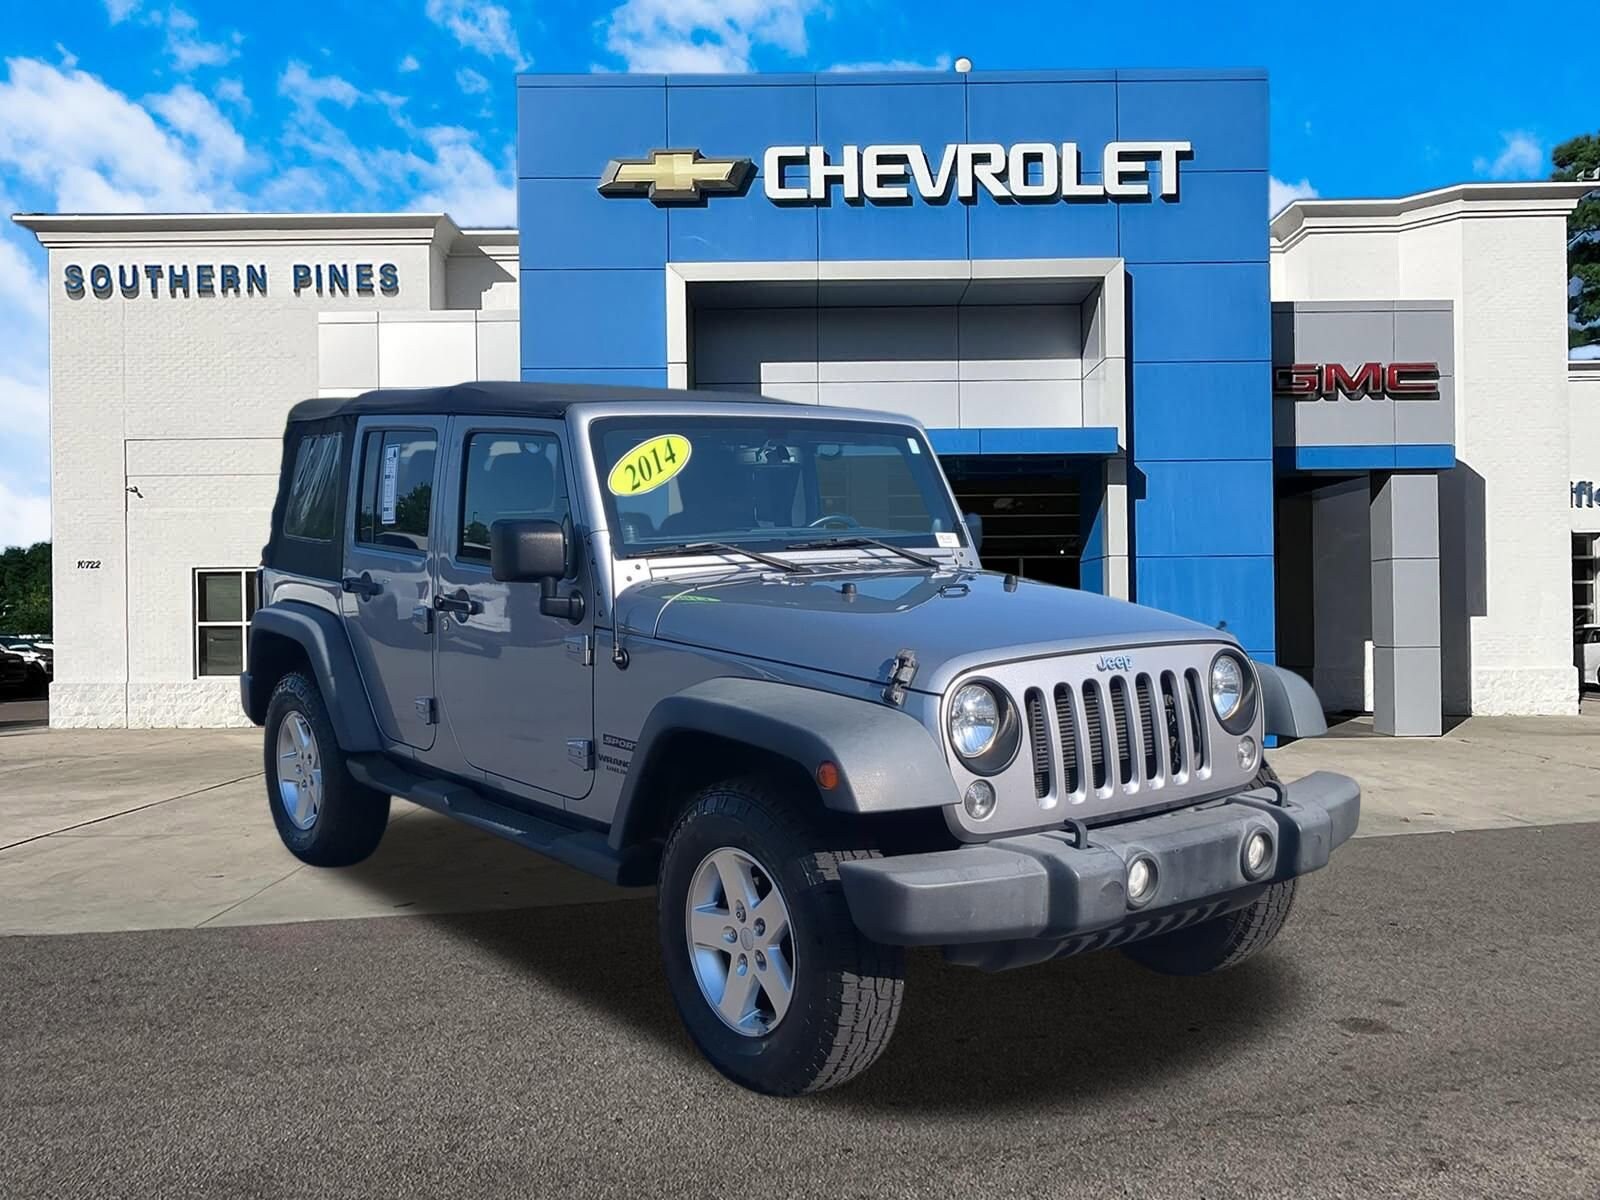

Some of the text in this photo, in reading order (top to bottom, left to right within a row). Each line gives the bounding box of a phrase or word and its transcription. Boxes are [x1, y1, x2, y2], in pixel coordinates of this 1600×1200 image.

[763, 140, 1192, 200] CHEVROLET
[64, 263, 399, 294] SOUTHERN PINES
[1274, 362, 1439, 397] GMC
[624, 439, 676, 491] 2014
[77, 559, 101, 569] 10722
[1097, 655, 1132, 672] Jeep
